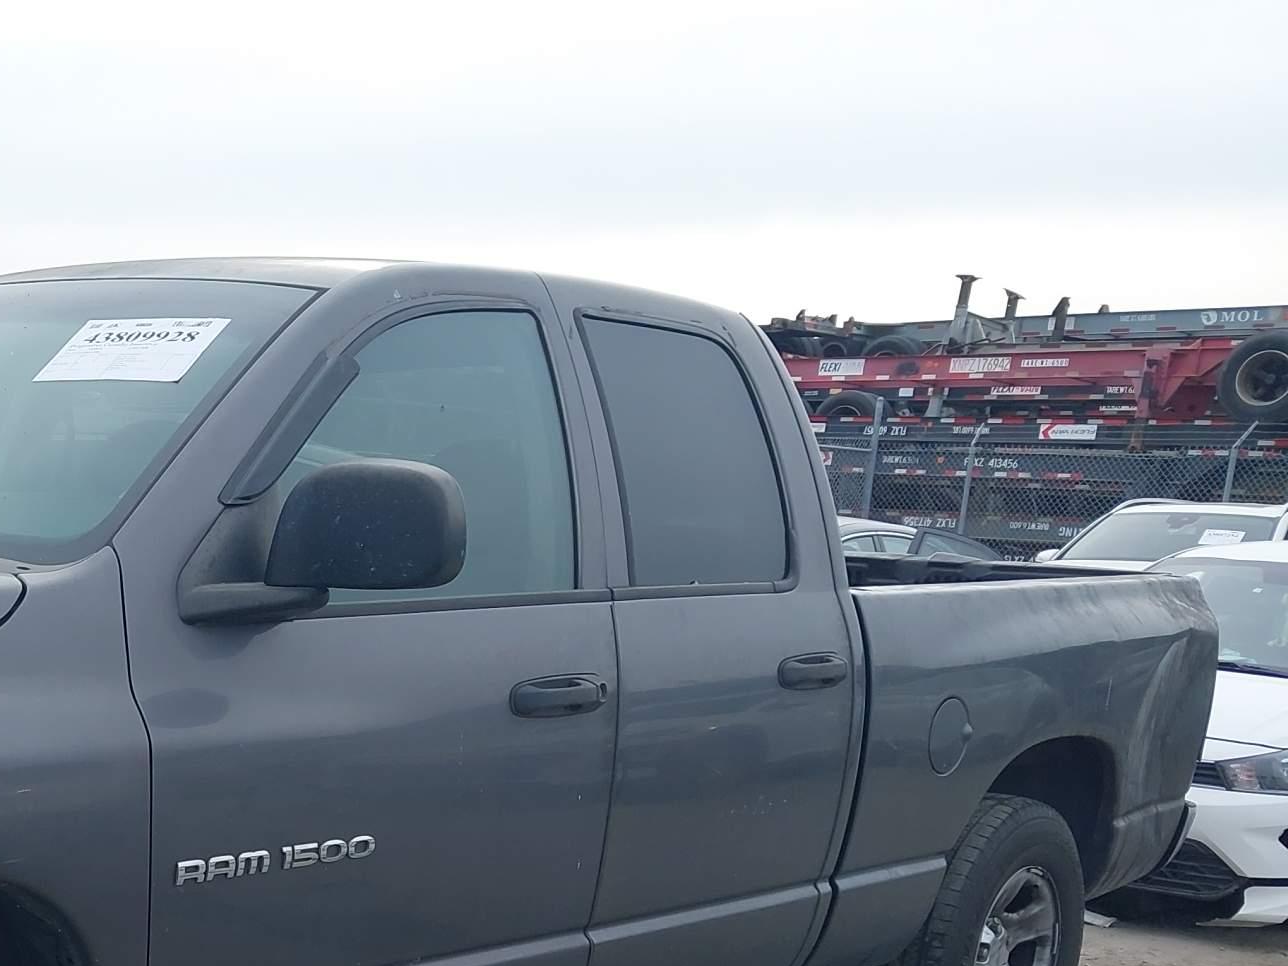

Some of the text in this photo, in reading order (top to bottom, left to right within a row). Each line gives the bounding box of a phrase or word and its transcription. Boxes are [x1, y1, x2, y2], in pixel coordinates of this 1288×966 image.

[1220, 310, 1264, 322] MOL
[84, 330, 201, 344] 43809928
[819, 361, 842, 373] FLEXI
[987, 457, 1019, 469] 413456
[936, 518, 957, 528] FLXZ
[176, 834, 377, 887] RAM 1500
